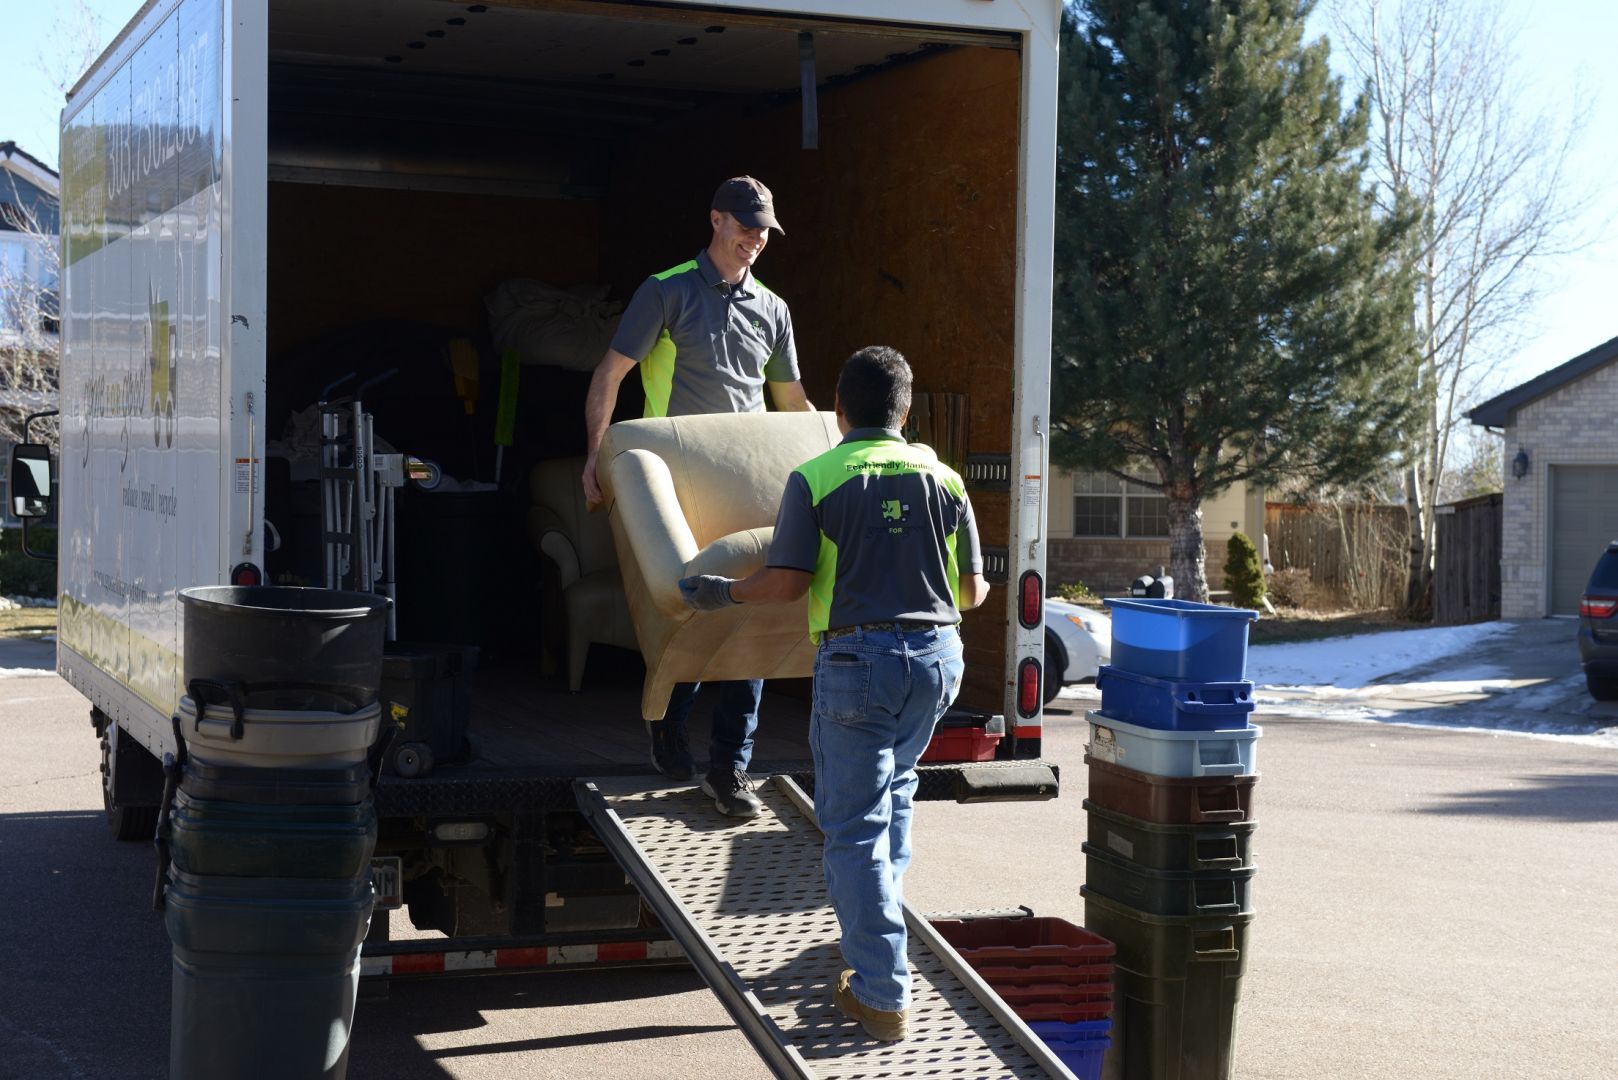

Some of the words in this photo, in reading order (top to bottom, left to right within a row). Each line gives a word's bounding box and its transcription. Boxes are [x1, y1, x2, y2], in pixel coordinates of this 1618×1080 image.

[108, 31, 208, 201] 303.736.2387
[847, 460, 900, 472] Ecofriendly
[158, 486, 177, 524] recycle
